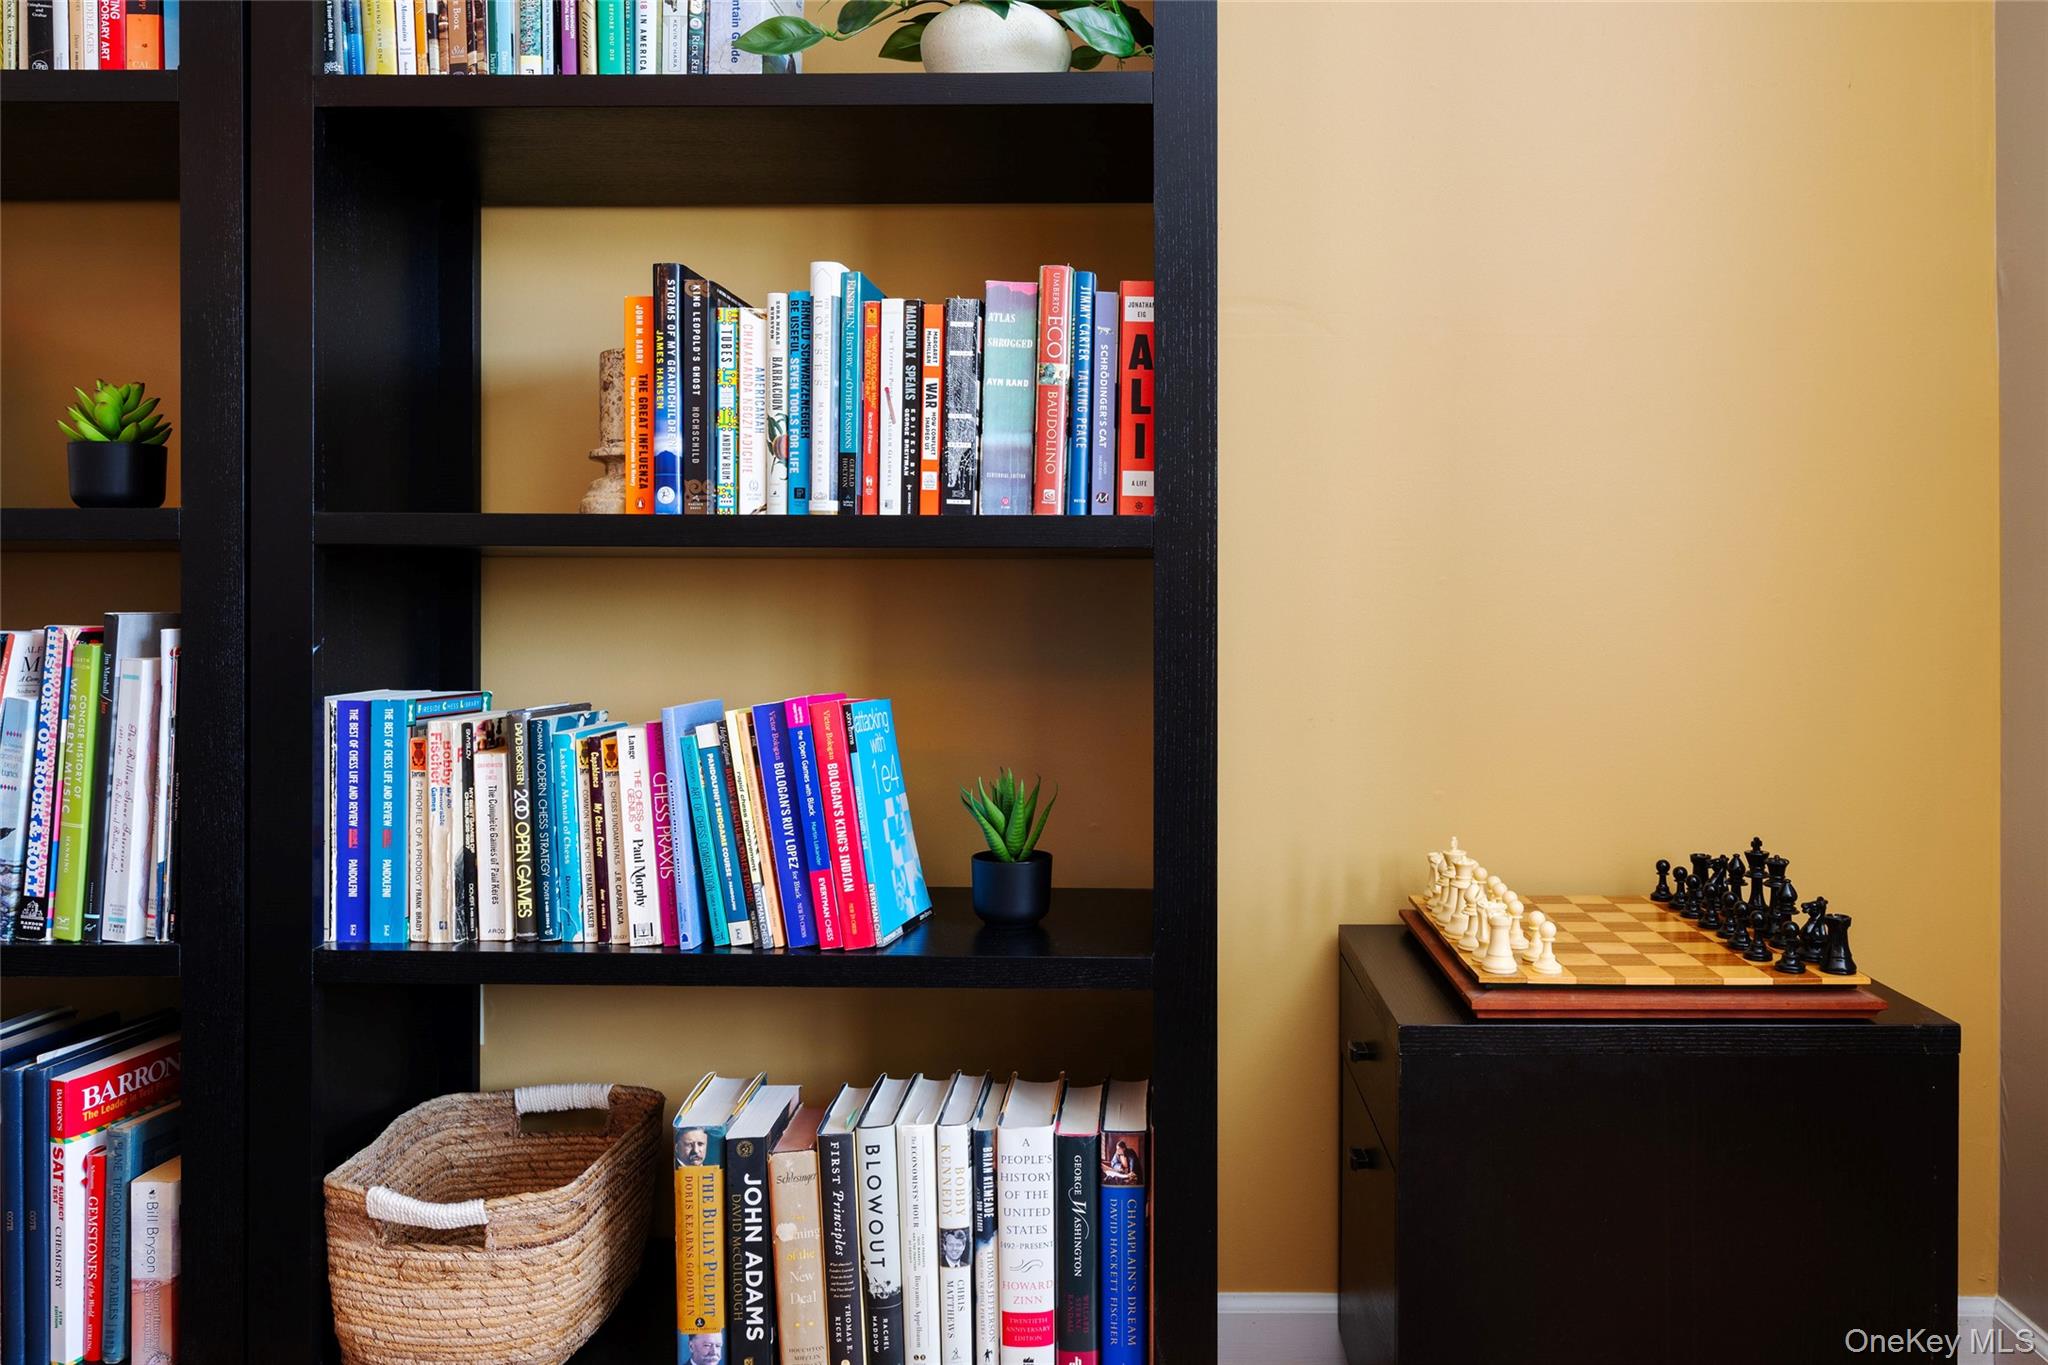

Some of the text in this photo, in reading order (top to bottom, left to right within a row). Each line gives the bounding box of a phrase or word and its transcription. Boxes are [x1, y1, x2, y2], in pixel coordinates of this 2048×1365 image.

[101, 41, 110, 60] ART
[667, 280, 675, 321] STORMS
[988, 314, 1016, 323] ATLAS
[1047, 273, 1063, 358] UMBERTO ECO
[667, 325, 676, 336] OF
[905, 306, 916, 348] MALCOLM
[1079, 286, 1092, 360] JIMMY CARTER
[667, 341, 676, 357] MY
[721, 330, 732, 363] TUBES
[656, 330, 664, 409] JAMES HANSEN
[772, 357, 782, 411] BARRACOON
[790, 300, 799, 473] BE USEFUL SEVEN TOOLS FOR LIFE
[905, 365, 916, 400] SPEAKS
[987, 378, 1028, 387] AYN RAND
[754, 367, 765, 433] AMERICANAH
[925, 383, 937, 408] WAR
[1076, 370, 1089, 448] TALKING PEACE
[639, 374, 649, 489] THE GREAT INFLUENZA
[1045, 392, 1056, 474] BAUDOLINO
[722, 434, 730, 480] ANDREW BLUM
[349, 722, 358, 738] BEST
[350, 709, 358, 721] THE
[384, 722, 393, 738] BEST
[385, 709, 393, 720] THE
[349, 740, 358, 748] OF
[349, 750, 358, 769] CHESS
[383, 750, 392, 768] CHESS
[384, 740, 392, 748] OF
[430, 732, 441, 784] Fischer
[628, 735, 637, 760] Lange
[349, 771, 358, 783] LIFE
[349, 786, 358, 799] AND
[383, 770, 392, 783] LIFE
[383, 785, 392, 799] AND
[349, 801, 358, 826] REVIEW
[383, 801, 392, 826] REVIEW
[537, 753, 550, 877] MODERN CHESS STRATEGY
[559, 748, 571, 864] Lasker's Manual of Chess
[653, 772, 675, 879] CHESS PRAXIS
[774, 762, 799, 869] BOLOGAN'S RUY LOPEZ
[826, 763, 854, 892] BOLOGAN'S KING'S INDIAN
[514, 789, 532, 918] 200 OPEN GAMES
[348, 859, 357, 897] PANDOLFINI
[382, 859, 391, 897] PANDOLFINI
[631, 839, 647, 908] Paul Morphy
[818, 877, 834, 941] EVERYMAN CHESS
[1001, 1154, 1053, 1165] PEOPLE'S
[1022, 1139, 1030, 1147] A
[53, 1147, 64, 1182] SAT
[830, 1142, 841, 1184] FIRST
[941, 1145, 952, 1217] KENNEDY
[982, 1147, 993, 1217] BRIAN KILMEADE
[1000, 1172, 1053, 1182] HISTORY
[1073, 1155, 1082, 1195] GEORGE
[865, 1145, 885, 1268] BLOWOUT
[955, 1167, 965, 1217] BOBBY
[1005, 1190, 1049, 1200] OF THE
[111, 1177, 122, 1259] TRIGONOMETRY
[831, 1190, 845, 1257] Principles
[1004, 1207, 1051, 1218] UNITED
[1006, 1225, 1048, 1234] STATES
[87, 1196, 98, 1279] GEMSTONES
[145, 1201, 159, 1273] Bill Bryson
[685, 1176, 695, 1316] DORIS KEARNS GOODWIN
[702, 1173, 717, 1318] THE BULLY PULPIT
[54, 1227, 62, 1288] CHEMISTRY
[110, 1264, 118, 1284] AND
[732, 1194, 743, 1321] DAVID McCULLOUGH
[744, 1173, 764, 1341] JOHN ADAMS
[790, 1271, 815, 1282] New
[1110, 1199, 1119, 1345] DAVID HACKETT FISCHER
[1126, 1199, 1137, 1346] CHAMPLAIN'S DREAM
[109, 1287, 118, 1321] TABLES
[790, 1293, 816, 1305] Deal
[957, 1279, 965, 1312] CHRIS
[1002, 1280, 1053, 1290] HOWARD
[1013, 1296, 1043, 1305] ZINN
[946, 1280, 955, 1339] MATTHEWS
